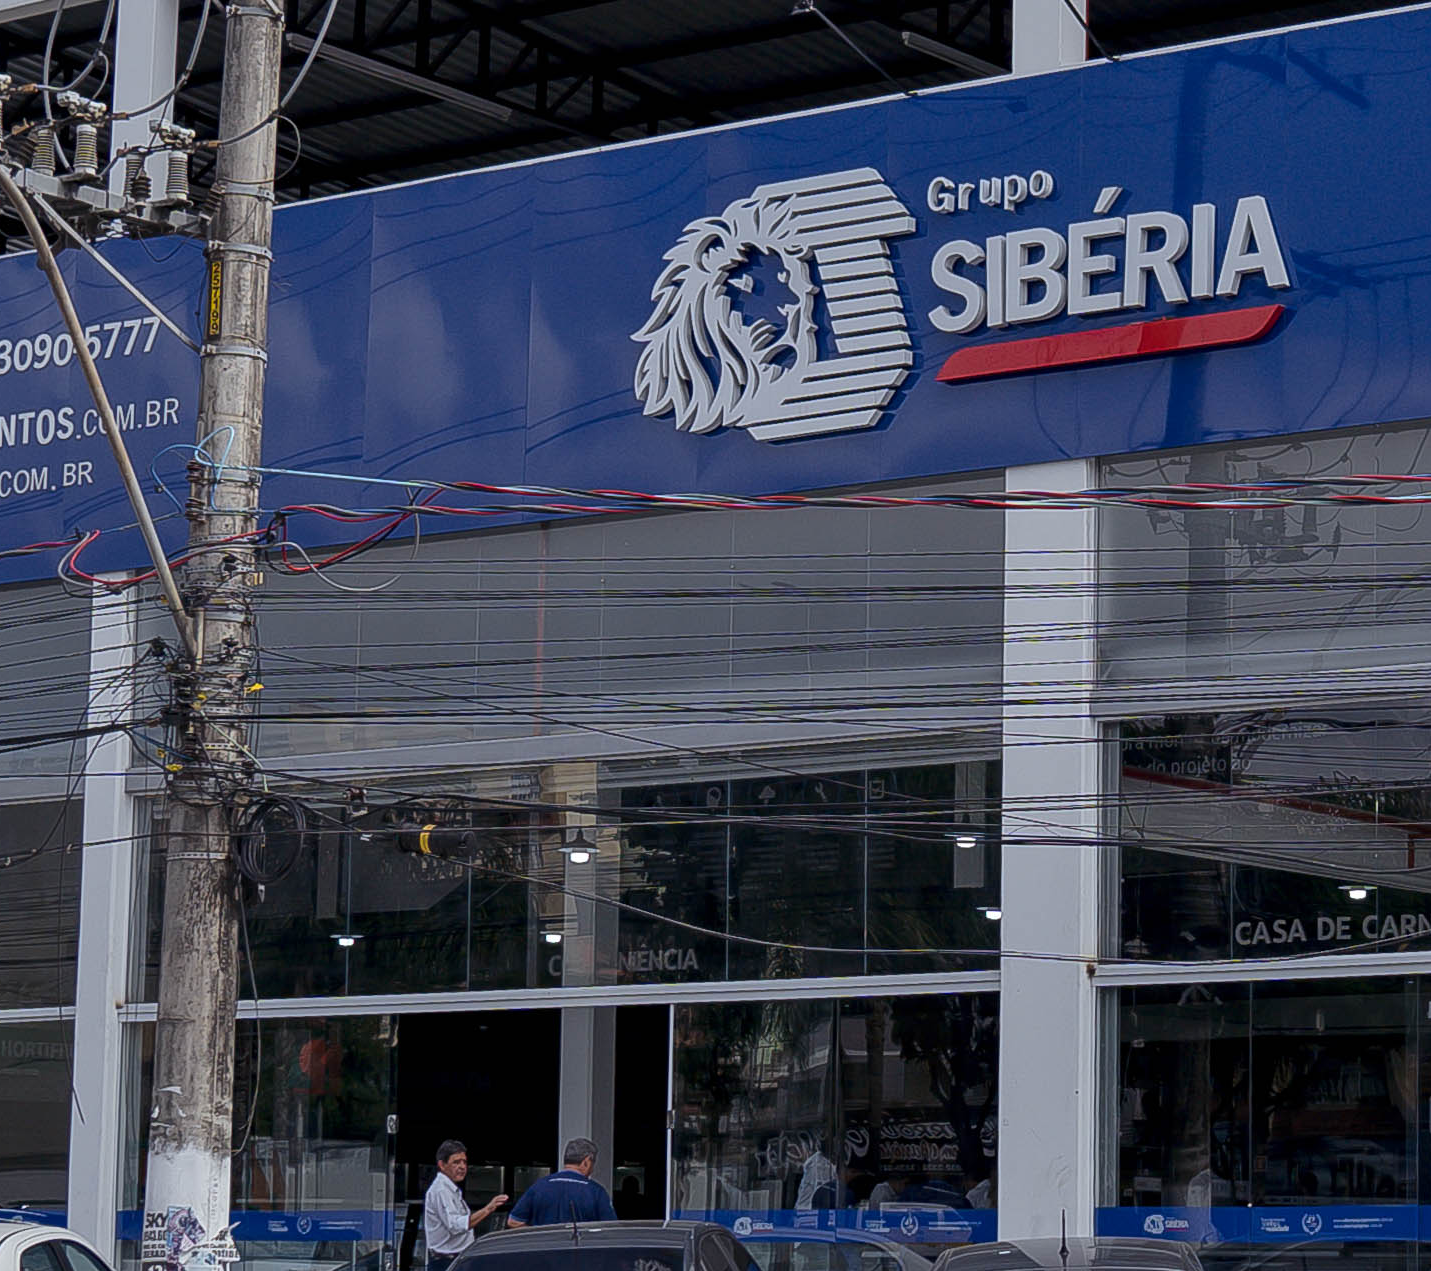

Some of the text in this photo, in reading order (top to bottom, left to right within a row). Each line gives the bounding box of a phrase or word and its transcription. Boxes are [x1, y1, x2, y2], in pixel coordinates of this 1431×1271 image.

[927, 169, 1055, 214] Grupo
[928, 186, 1291, 334] SIBÉRIA
[1235, 918, 1308, 946] CASA
[1316, 916, 1352, 941] DE
